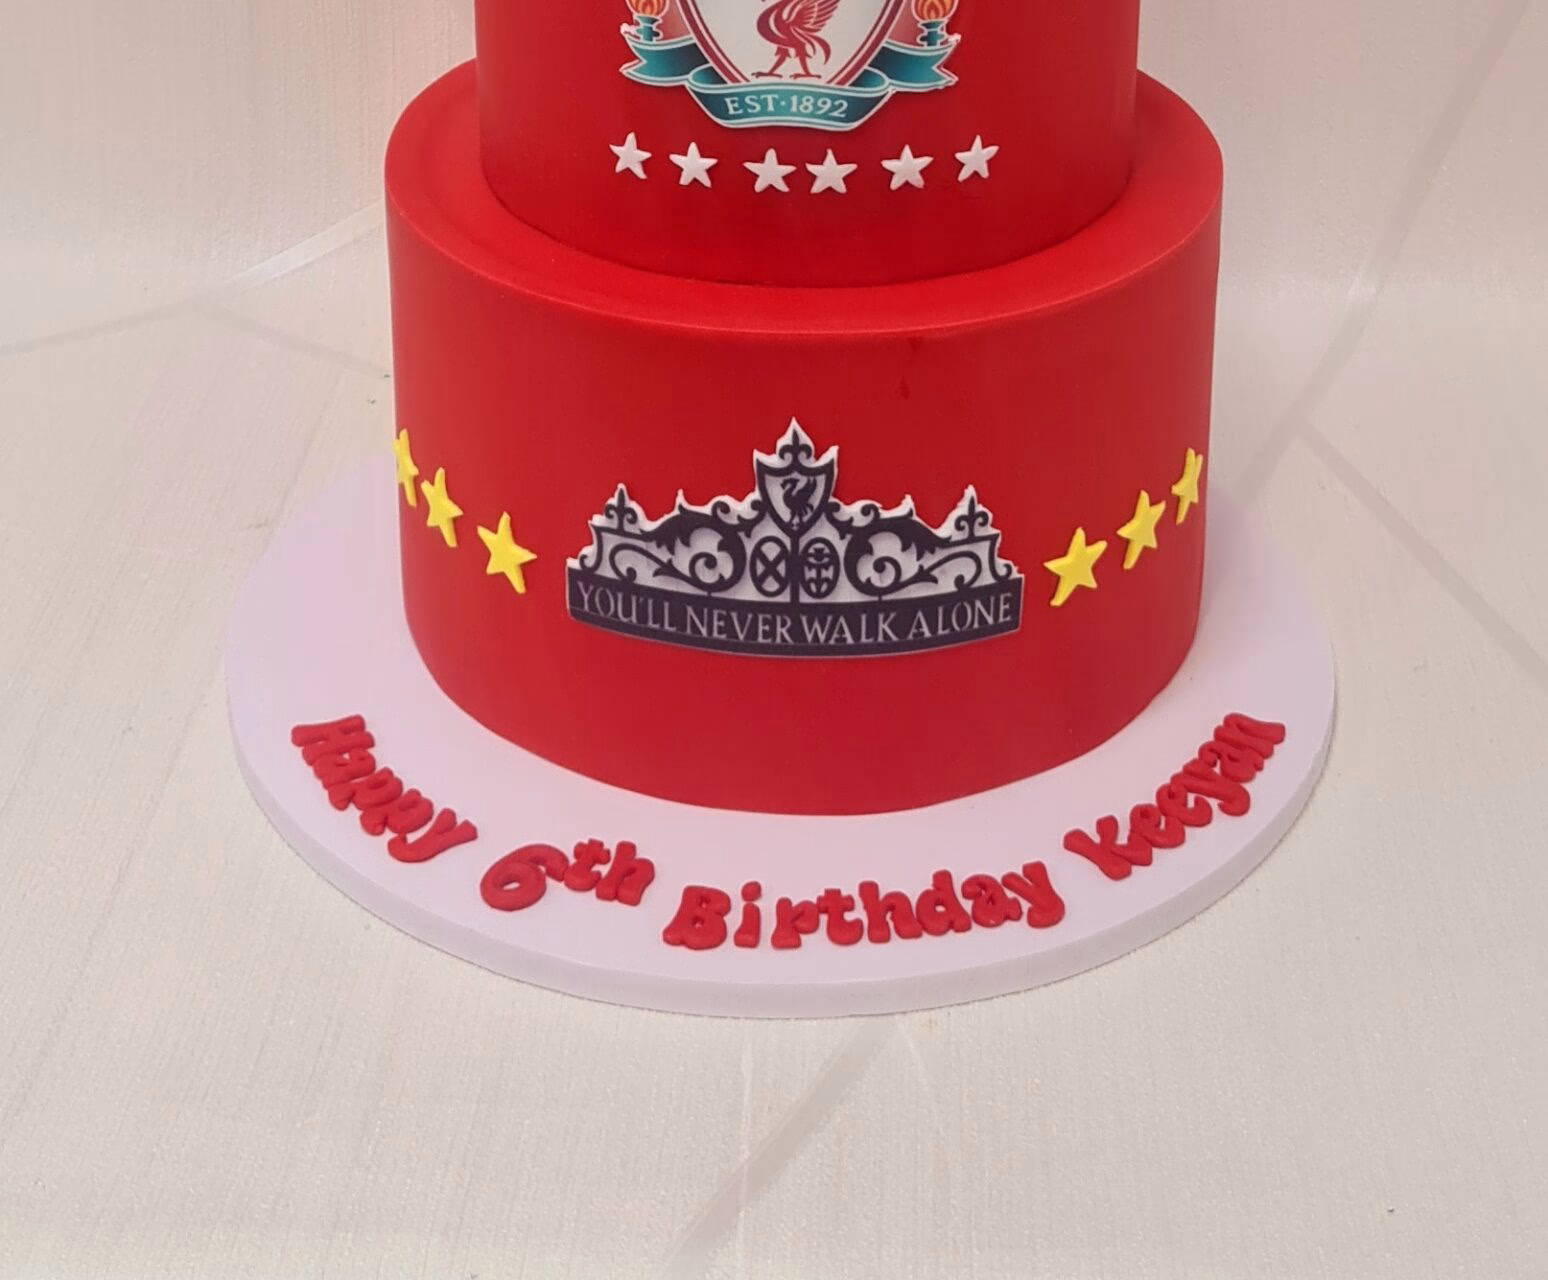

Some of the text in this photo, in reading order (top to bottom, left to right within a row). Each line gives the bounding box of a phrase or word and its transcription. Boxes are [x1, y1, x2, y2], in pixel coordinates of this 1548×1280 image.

[576, 581, 1013, 645] YOU'LL NEVER WALK ALONE
[291, 712, 1286, 951] Happy 6th Birthday Keeyan
